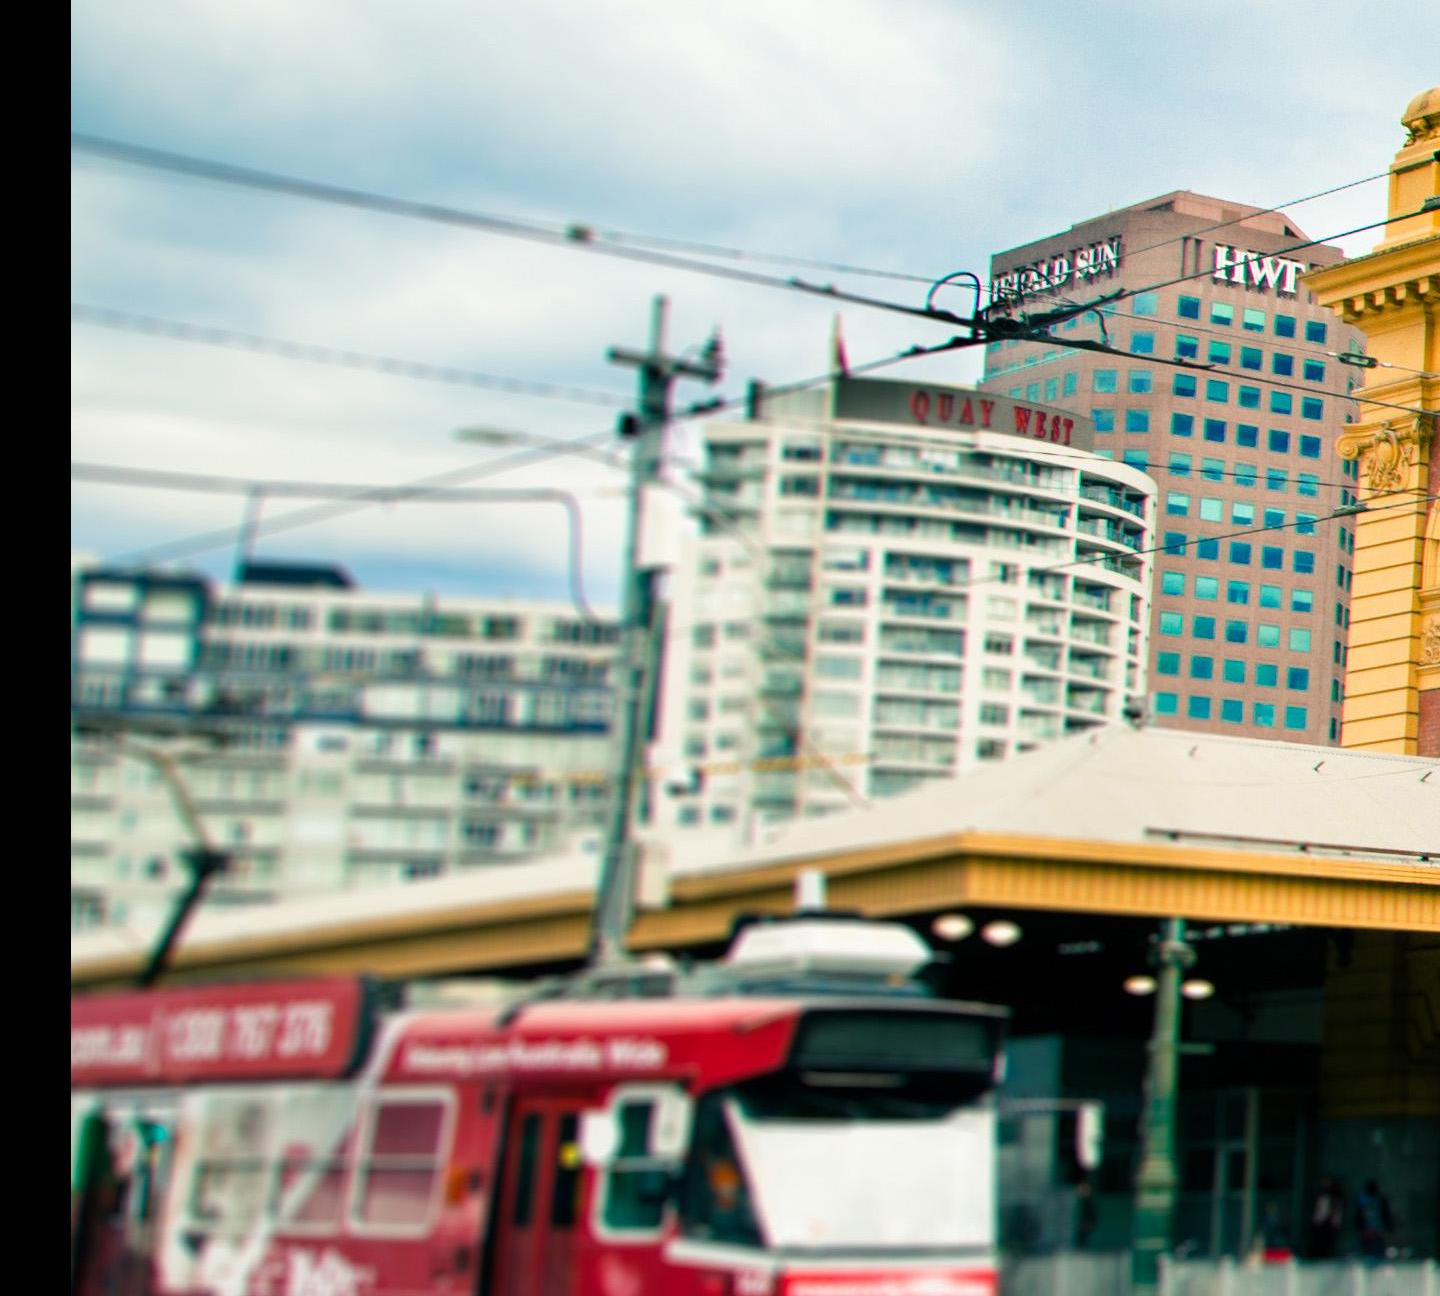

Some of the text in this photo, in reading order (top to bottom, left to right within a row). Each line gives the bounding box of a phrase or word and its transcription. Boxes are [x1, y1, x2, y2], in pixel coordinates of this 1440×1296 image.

[1075, 241, 1119, 280] SUN
[1213, 243, 1305, 293] HWT
[910, 389, 1074, 445] QUAY WEST
